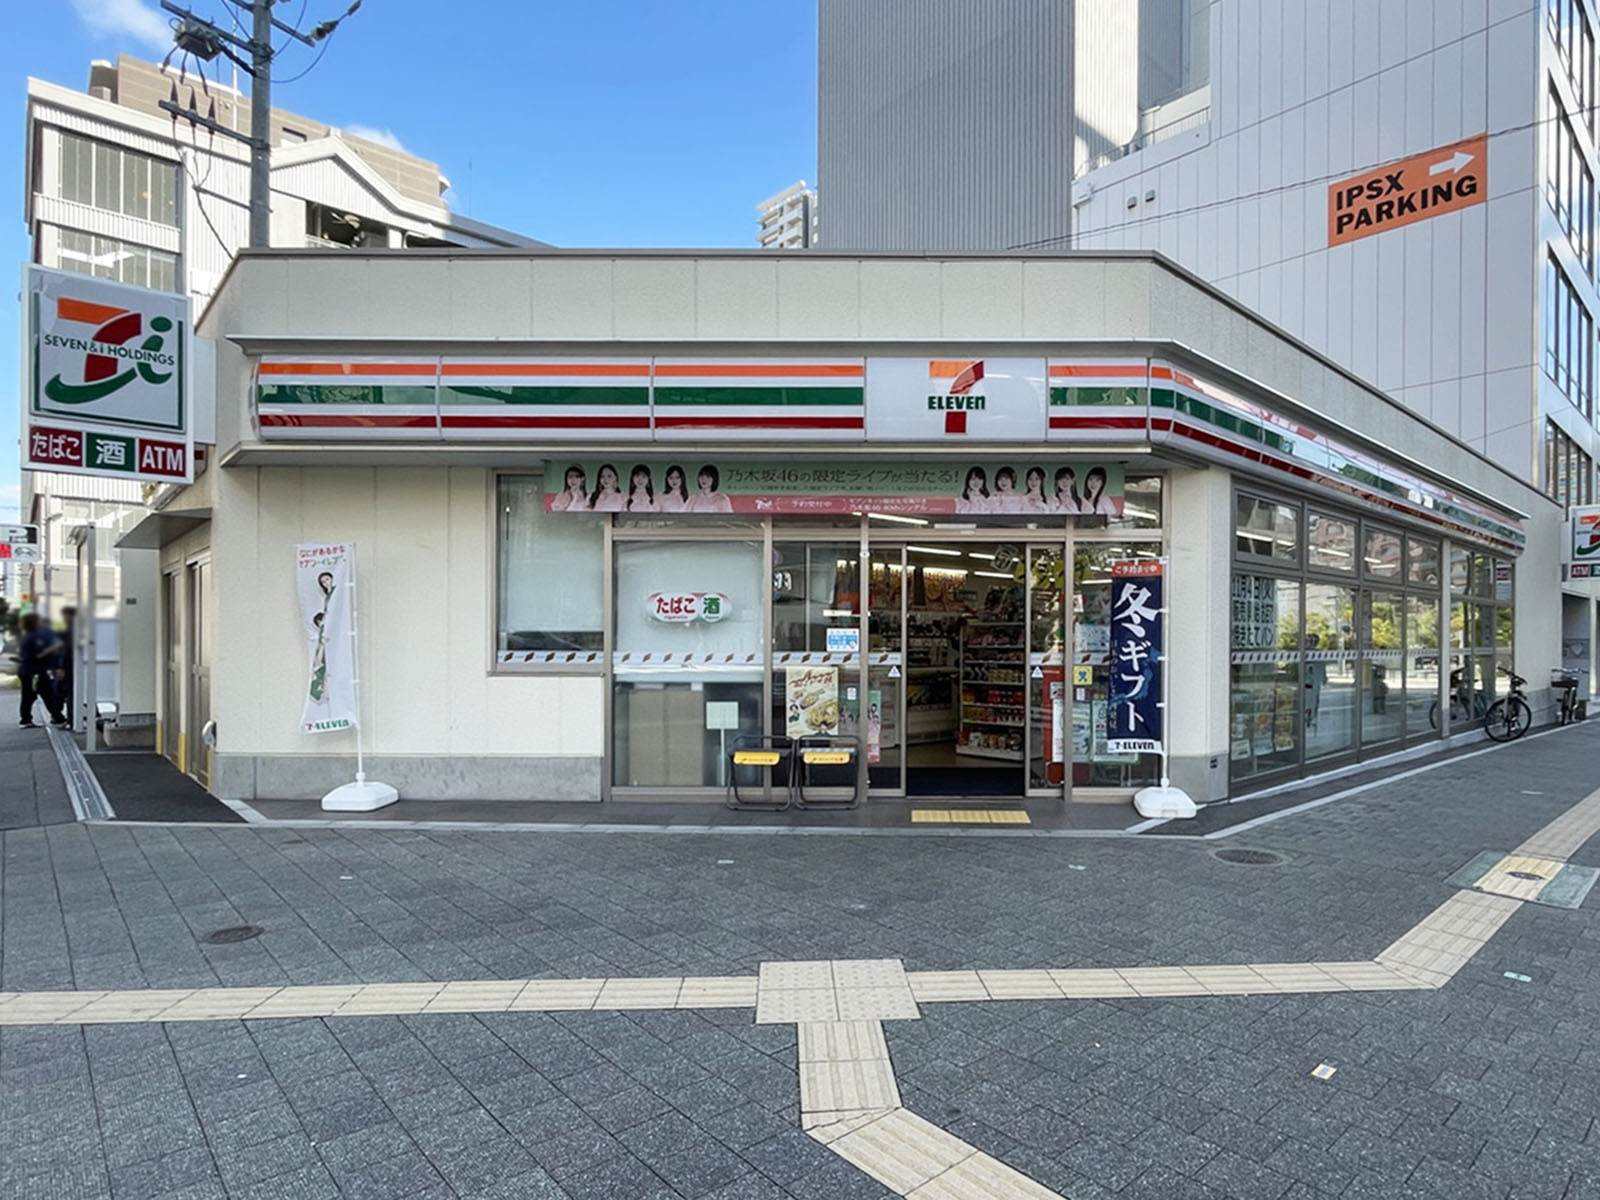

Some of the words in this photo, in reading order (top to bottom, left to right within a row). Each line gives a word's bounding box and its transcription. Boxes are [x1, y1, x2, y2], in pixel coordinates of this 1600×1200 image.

[1336, 170, 1404, 211] IPSX
[1336, 175, 1477, 235] PARKING
[107, 345, 175, 366] HOLDINGS
[32, 432, 80, 461] たばこ
[96, 438, 127, 466] 酒
[141, 445, 184, 472] ATM
[656, 597, 696, 614] たばこ
[703, 597, 720, 614] 酒
[1113, 582, 1159, 732] 冬ギフト
